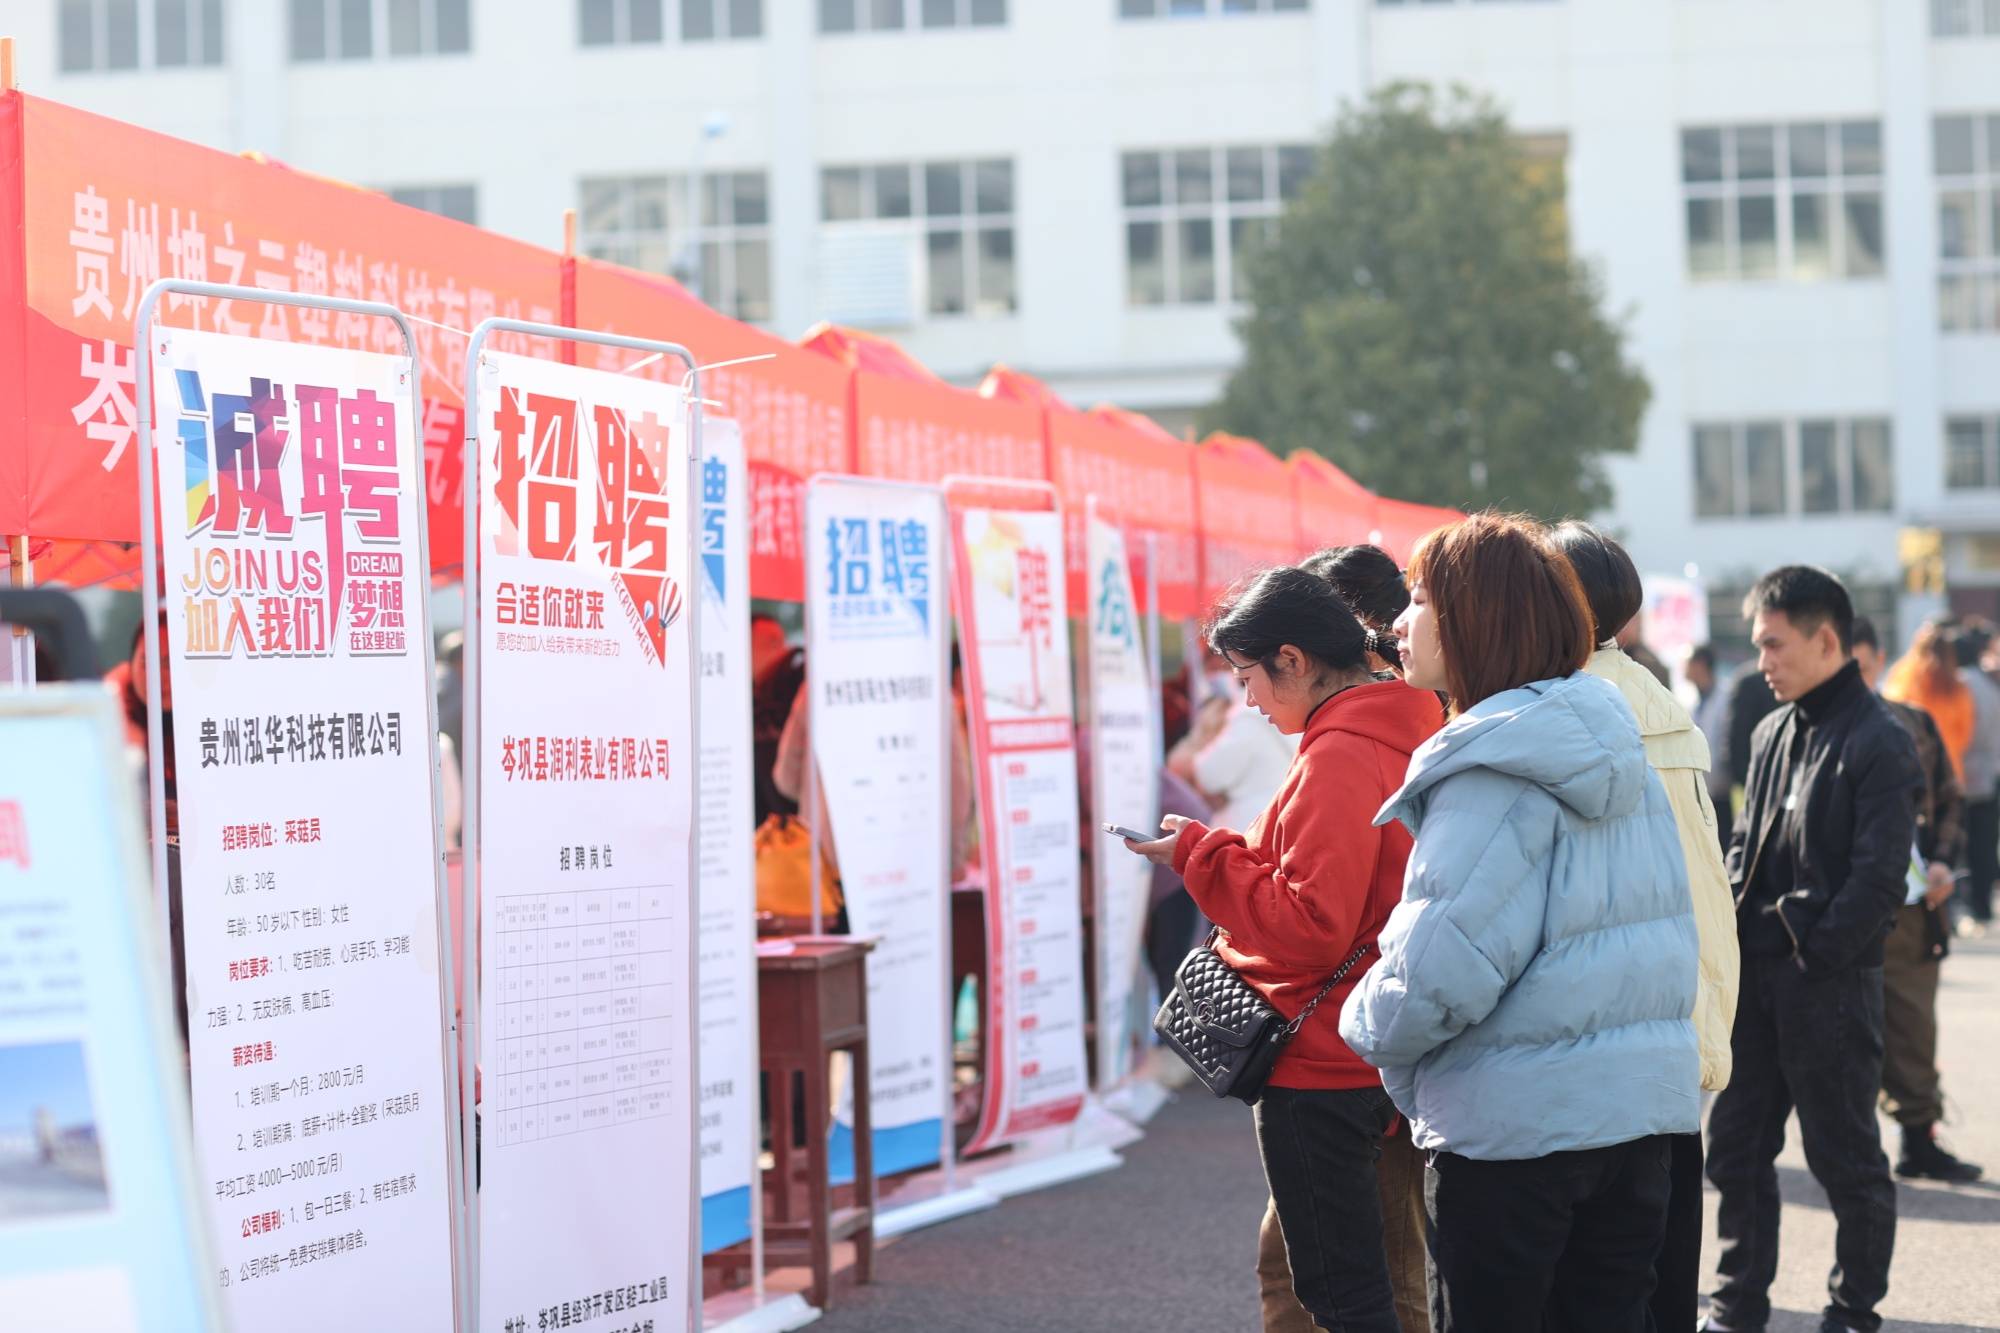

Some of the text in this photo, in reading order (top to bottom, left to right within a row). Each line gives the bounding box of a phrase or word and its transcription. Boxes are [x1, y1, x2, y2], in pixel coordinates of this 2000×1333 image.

[494, 386, 669, 572] 招聘
[183, 548, 322, 592] JOIN US
[350, 555, 400, 573] DREAM
[826, 517, 929, 597] 招聘
[185, 597, 326, 652] 加入我们
[347, 580, 405, 629] 梦想
[497, 582, 605, 630] 合适你就来
[611, 571, 657, 666] RECRUITMENT
[350, 631, 406, 651] 在这里起航
[200, 711, 402, 769] 贵州泓华科技有限公司
[502, 735, 669, 782] 岑巩县润利表业有限公司
[559, 844, 613, 871] 招聘岗位
[225, 871, 276, 896] 人数：30名
